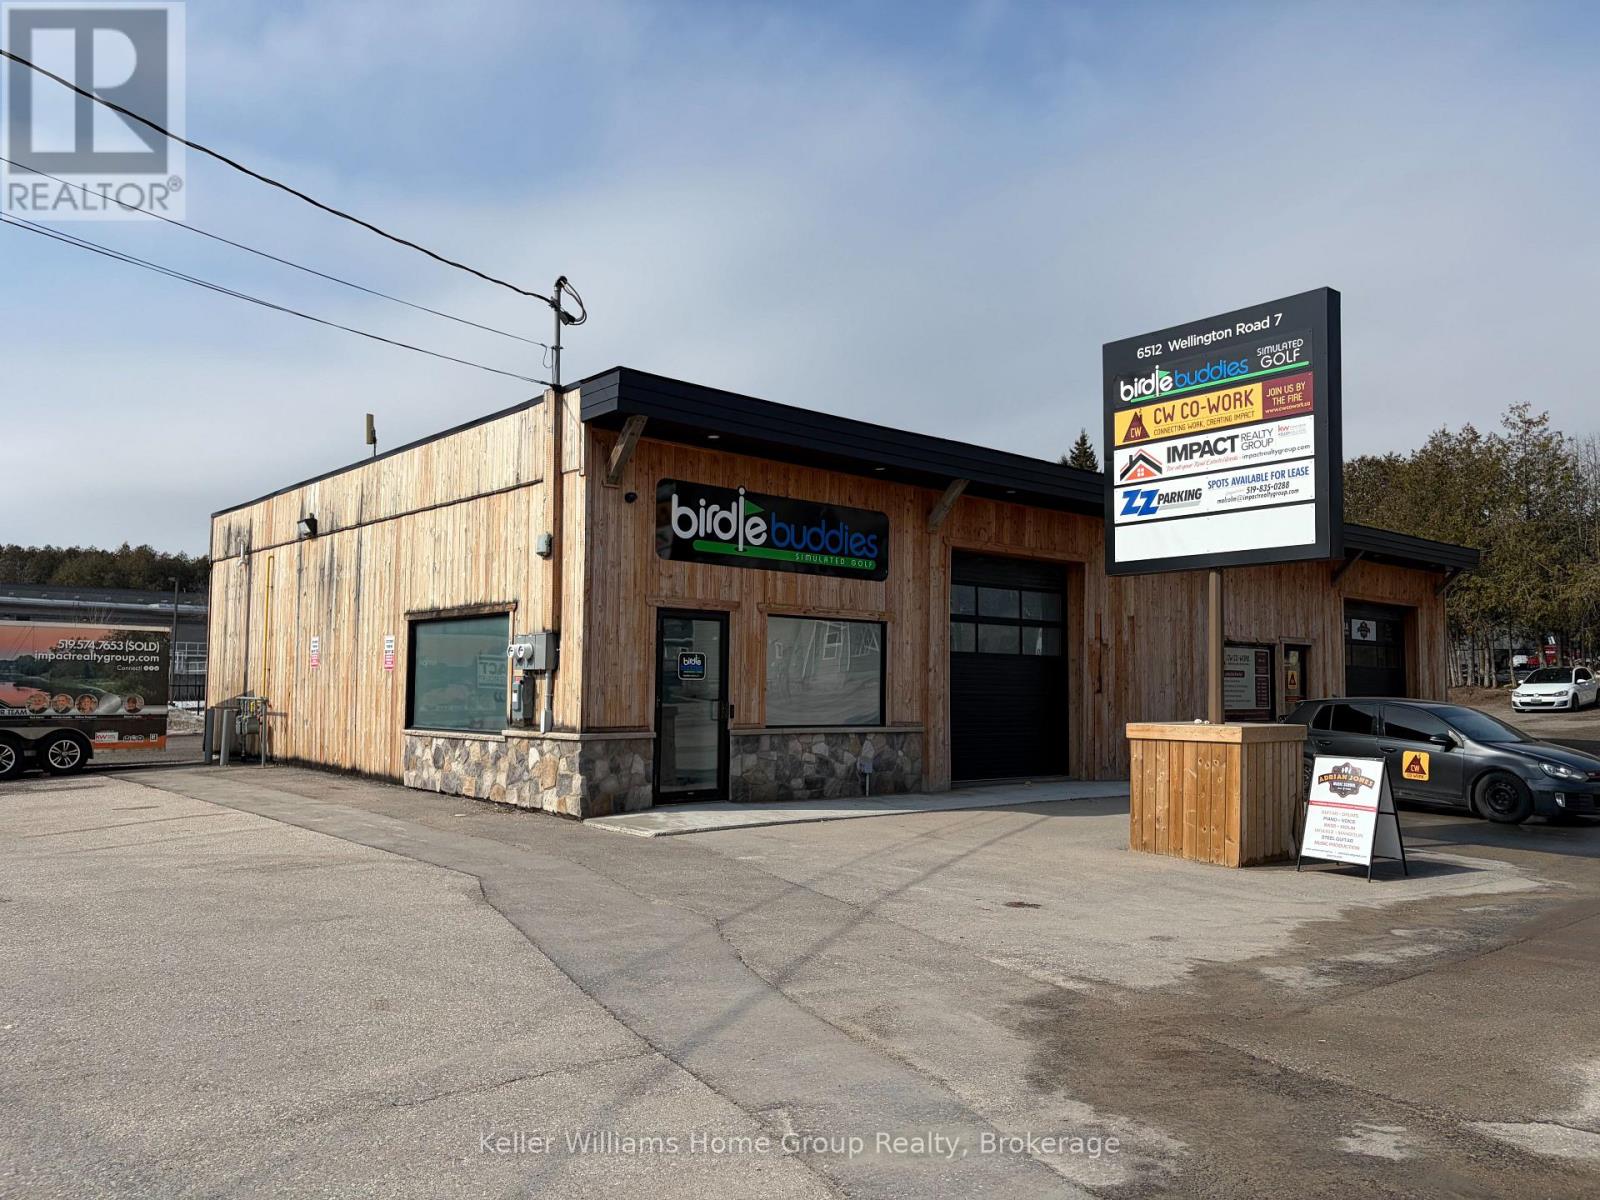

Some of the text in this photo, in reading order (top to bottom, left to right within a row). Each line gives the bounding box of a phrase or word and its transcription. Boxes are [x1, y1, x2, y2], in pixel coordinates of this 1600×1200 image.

[1136, 312, 1283, 359] 6512 Wellington Road 7
[1256, 338, 1304, 357] SIMULATED
[1260, 348, 1301, 369] GOLF
[1119, 358, 1249, 402] birdie buddies
[1266, 381, 1306, 398] JOIN US BY
[1153, 388, 1254, 425] CW CO-WORK
[1272, 391, 1303, 407] THE FIRE
[1153, 423, 1185, 436] CONNECTING
[1206, 415, 1233, 428] CREATING
[1234, 410, 1255, 423] IMPACT
[1130, 426, 1142, 439] CW
[1240, 428, 1274, 442] REALTY
[1166, 434, 1239, 464] IMPACT
[1241, 437, 1274, 451] GROUP
[1242, 443, 1310, 460] impactrealtygroup.com
[1207, 465, 1310, 490] SPOTS AVAILABLE FOR LEASE
[1120, 487, 1202, 516] ZZ PARKING
[671, 487, 878, 559] birdie buddies
[795, 553, 873, 569] SIMULATED GOLF
[57, 639, 160, 653] 519.574.7653 (SOLD)
[34, 650, 160, 664] impactrealtygroup.com
[7, 708, 28, 716] TEAM
[1319, 773, 1348, 783] ADRIAN
[1349, 774, 1375, 786] JONES
